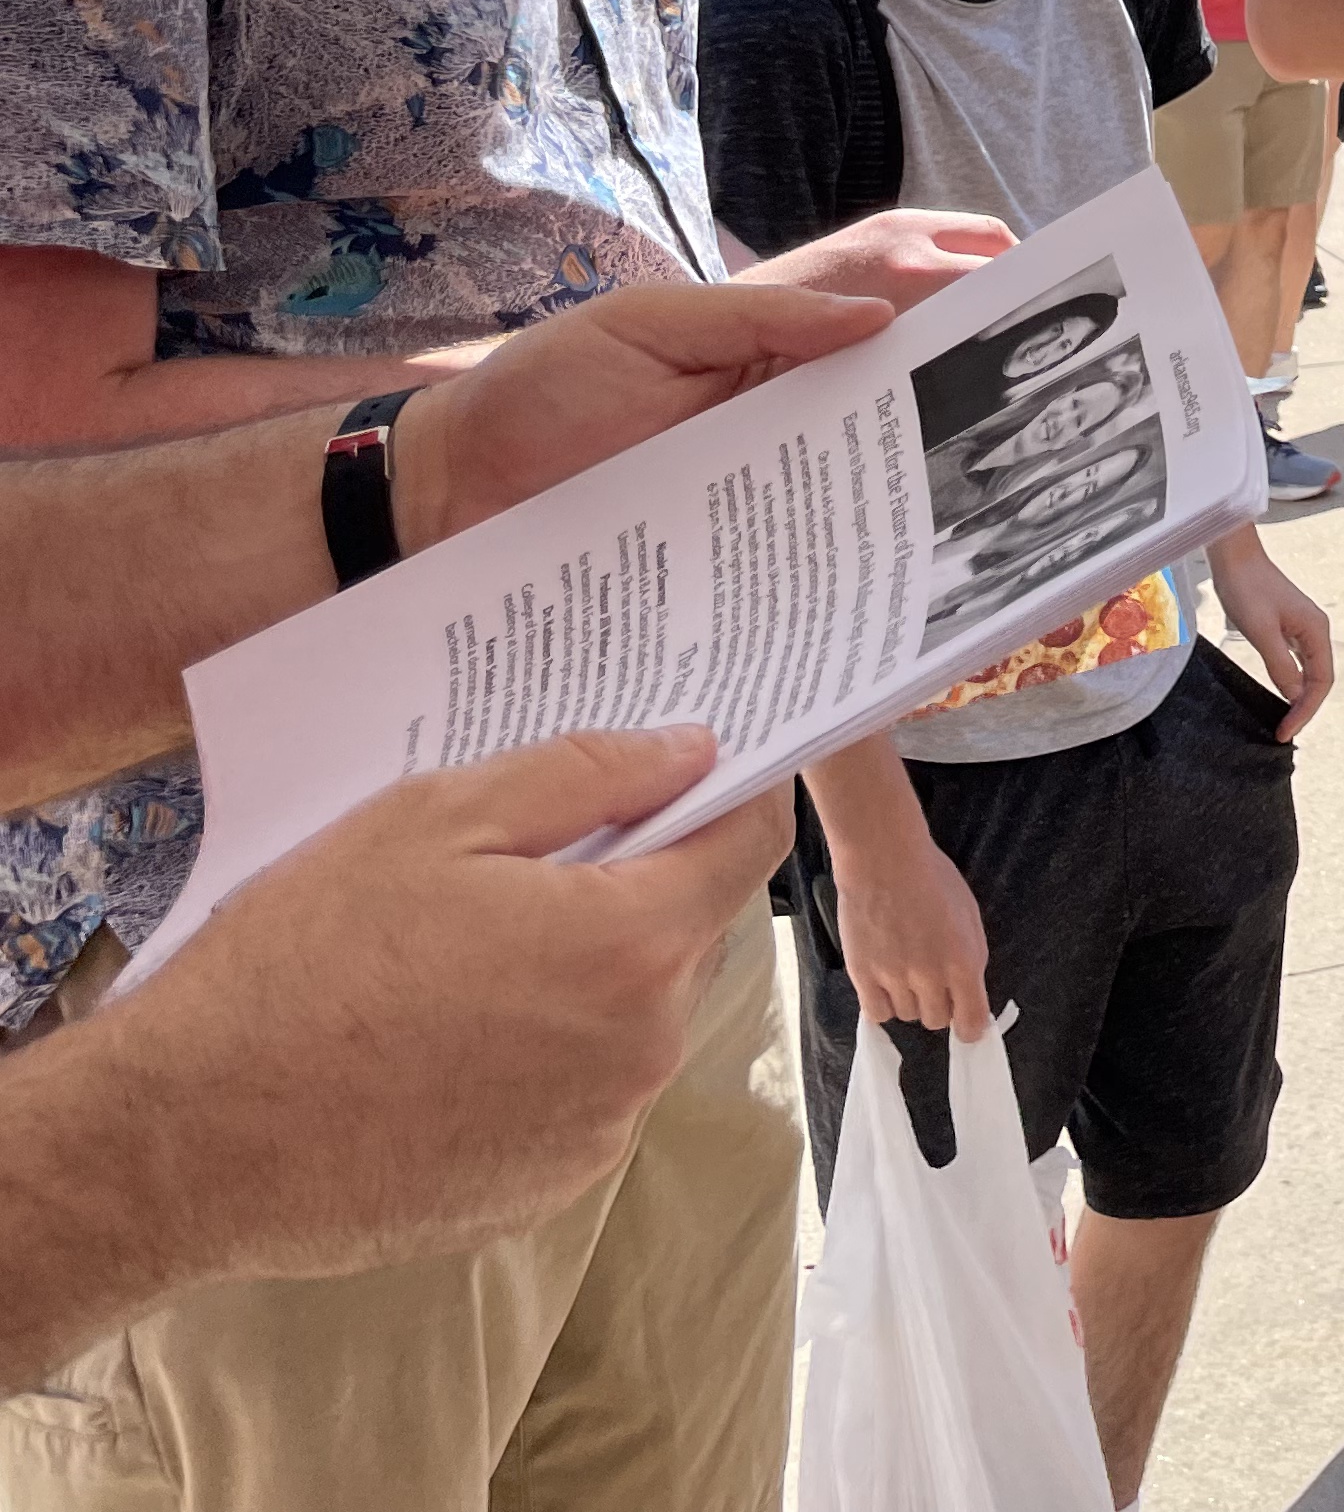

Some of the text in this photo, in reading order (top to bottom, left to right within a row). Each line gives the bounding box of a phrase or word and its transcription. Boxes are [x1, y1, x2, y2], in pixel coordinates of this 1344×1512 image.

[876, 388, 894, 420] The
[1169, 350, 1201, 441] arkansas965.org
[842, 412, 858, 454] Experts
[878, 417, 901, 454] Fight
[817, 450, 829, 464] On
[849, 452, 862, 466] to
[885, 450, 903, 472] for
[785, 486, 794, 504] who
[851, 463, 865, 503] Discuss
[887, 470, 906, 495] the
[634, 521, 646, 541] She
[822, 511, 834, 548] Supreme
[851, 500, 869, 540] Impact
[890, 493, 908, 539] Future
[579, 551, 590, 567] for
[637, 540, 649, 576] received
[857, 540, 874, 553] of
[894, 539, 913, 554] of
[560, 563, 572, 593] expert
[581, 566, 592, 606] Research
[621, 575, 633, 593] She
[749, 572, 761, 589] and
[521, 583, 534, 619] College
[563, 593, 573, 606] on
[599, 573, 610, 614] Professor
[621, 591, 632, 609] has
[503, 593, 515, 637] residency
[524, 619, 537, 629] of
[542, 604, 553, 621] Dr.
[579, 612, 593, 643] Faculty
[620, 608, 631, 636] served
[445, 622, 459, 665] bachelor
[463, 614, 477, 648] earned
[507, 638, 517, 649] at
[542, 619, 553, 660] Kathleen
[563, 606, 574, 658] reproductive
[467, 649, 476, 657] a
[485, 636, 496, 666] Karen
[676, 642, 697, 672] The
[450, 666, 461, 677] of
[466, 656, 478, 697] doctorate
[503, 647, 517, 689] University
[560, 658, 573, 682] rights
[577, 641, 592, 695] Development
[448, 677, 460, 709] science
[466, 696, 476, 707] in
[504, 689, 515, 699] of
[521, 683, 532, 701] and
